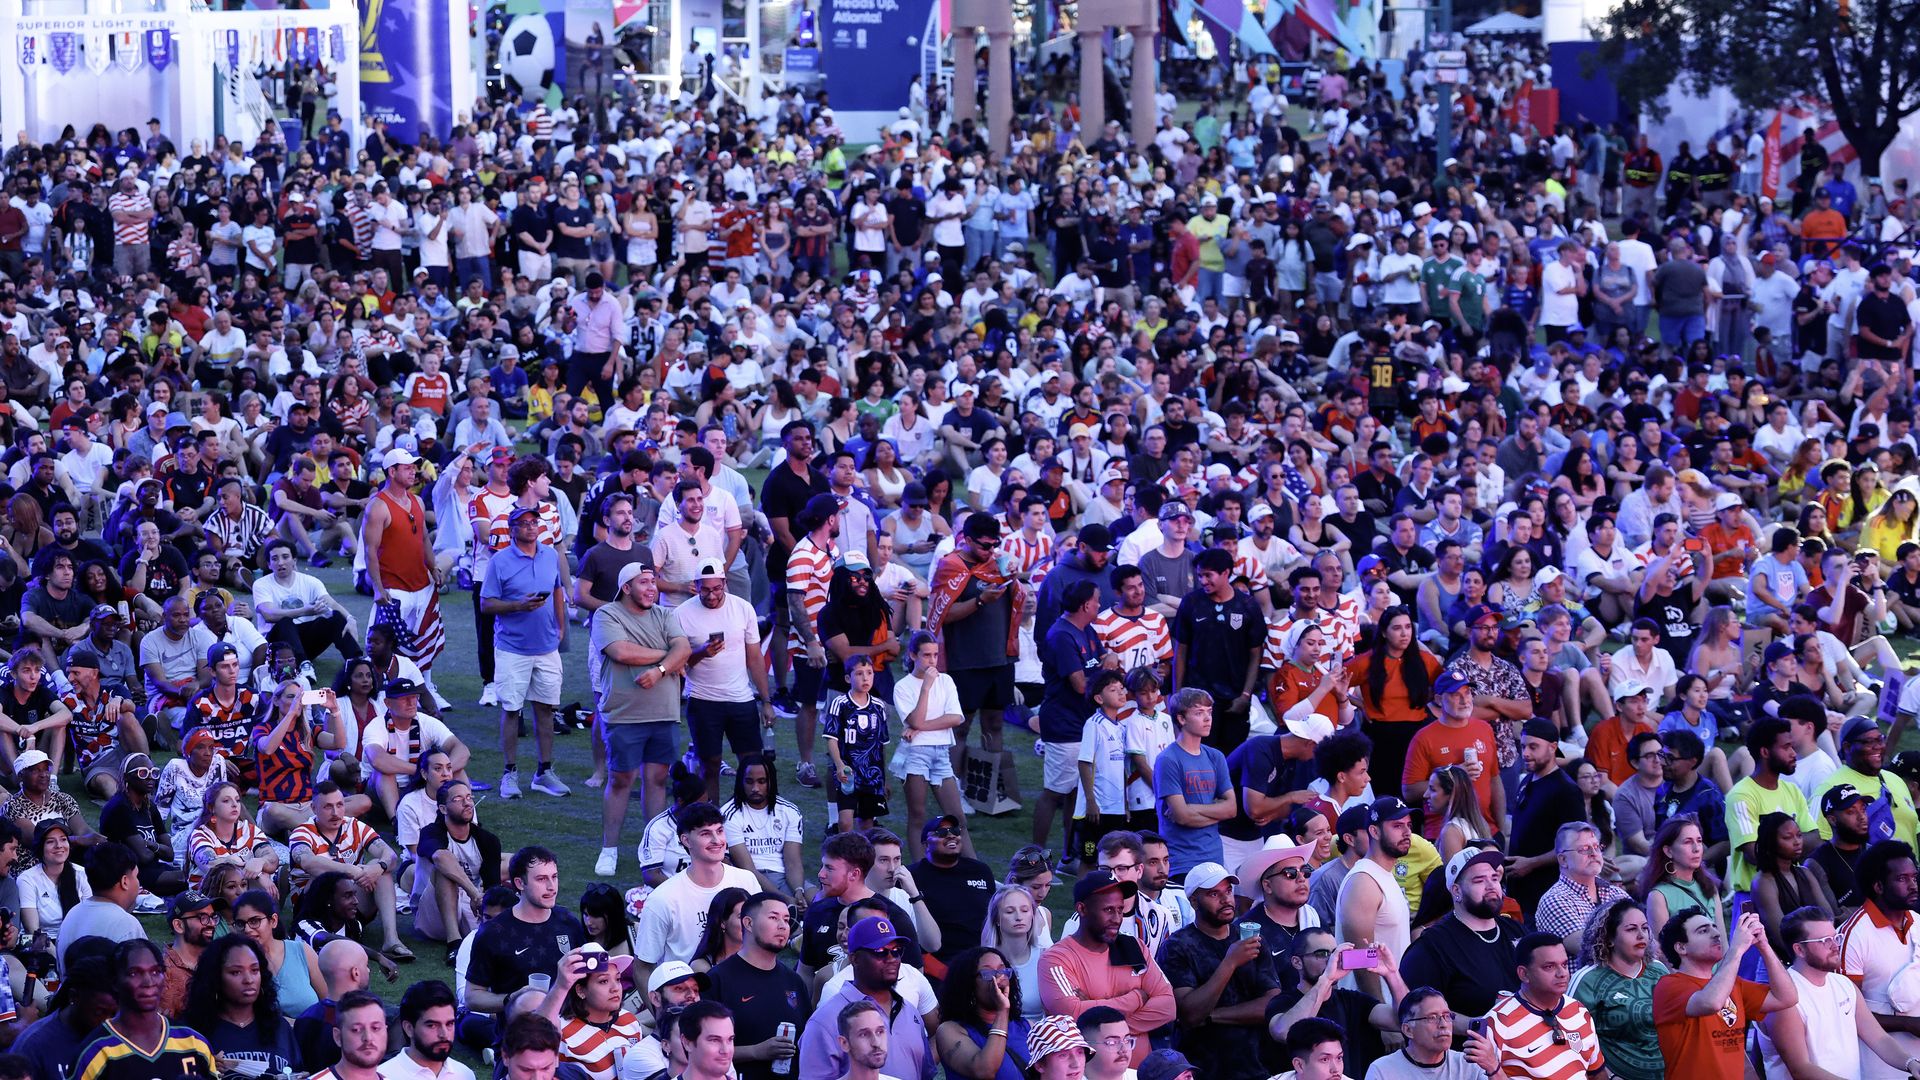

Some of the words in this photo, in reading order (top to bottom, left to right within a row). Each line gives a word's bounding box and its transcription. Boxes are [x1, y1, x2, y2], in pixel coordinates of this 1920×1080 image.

[832, 10, 882, 24] Atlanta!
[17, 20, 85, 30] SUPERIOR
[93, 21, 133, 29] LIGHT
[140, 20, 175, 28] BEER
[1132, 647, 1148, 667] 76
[211, 725, 248, 740] USA
[844, 728, 857, 744] 10
[744, 836, 783, 847] Emirates
